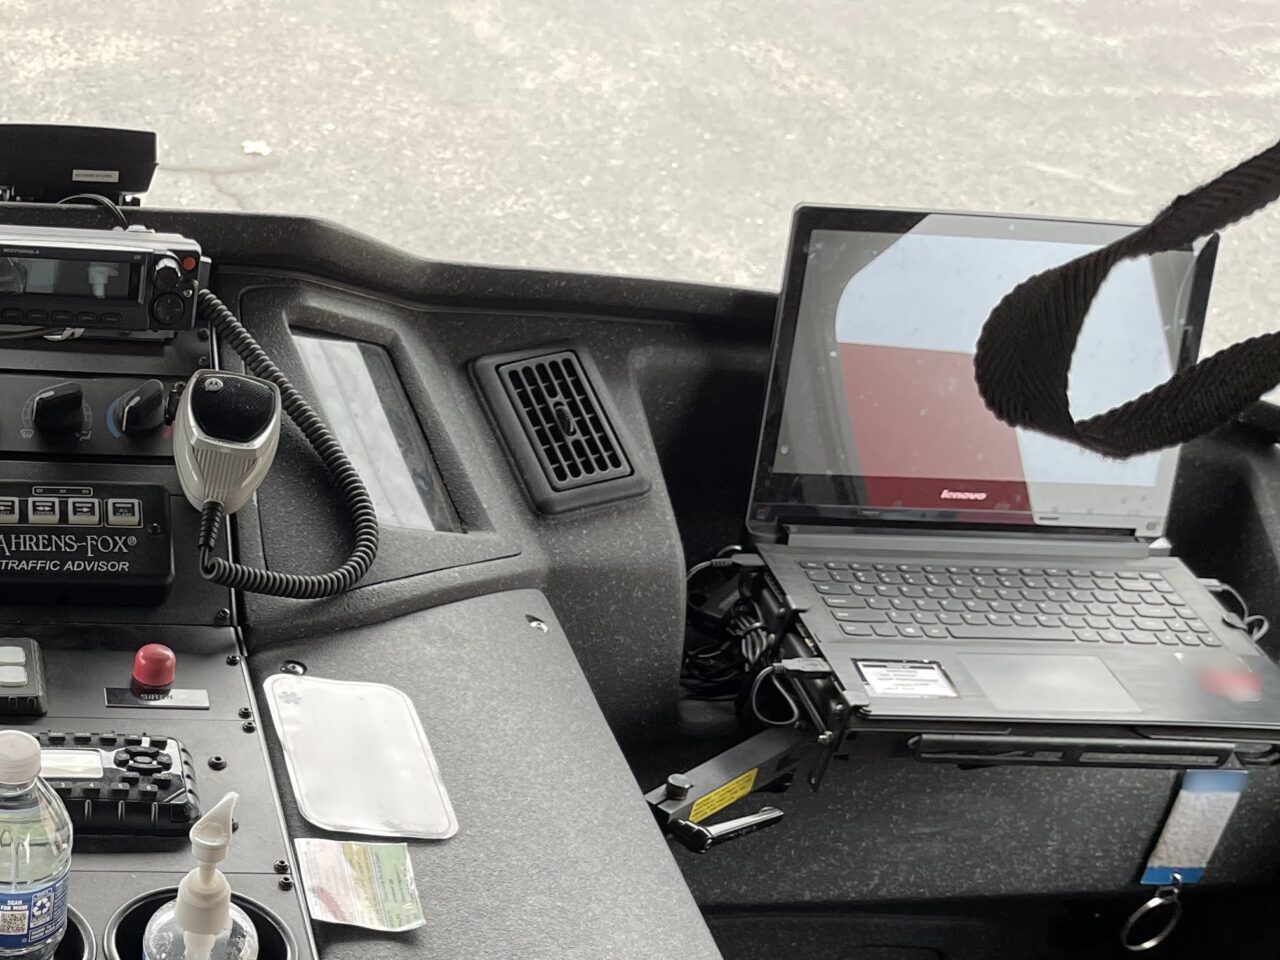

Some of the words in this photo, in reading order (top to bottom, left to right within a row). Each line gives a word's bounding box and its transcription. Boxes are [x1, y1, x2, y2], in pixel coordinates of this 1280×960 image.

[940, 489, 987, 500] lenovo
[0, 560, 60, 571] TRAFFIC
[63, 560, 130, 572] ADVISOR
